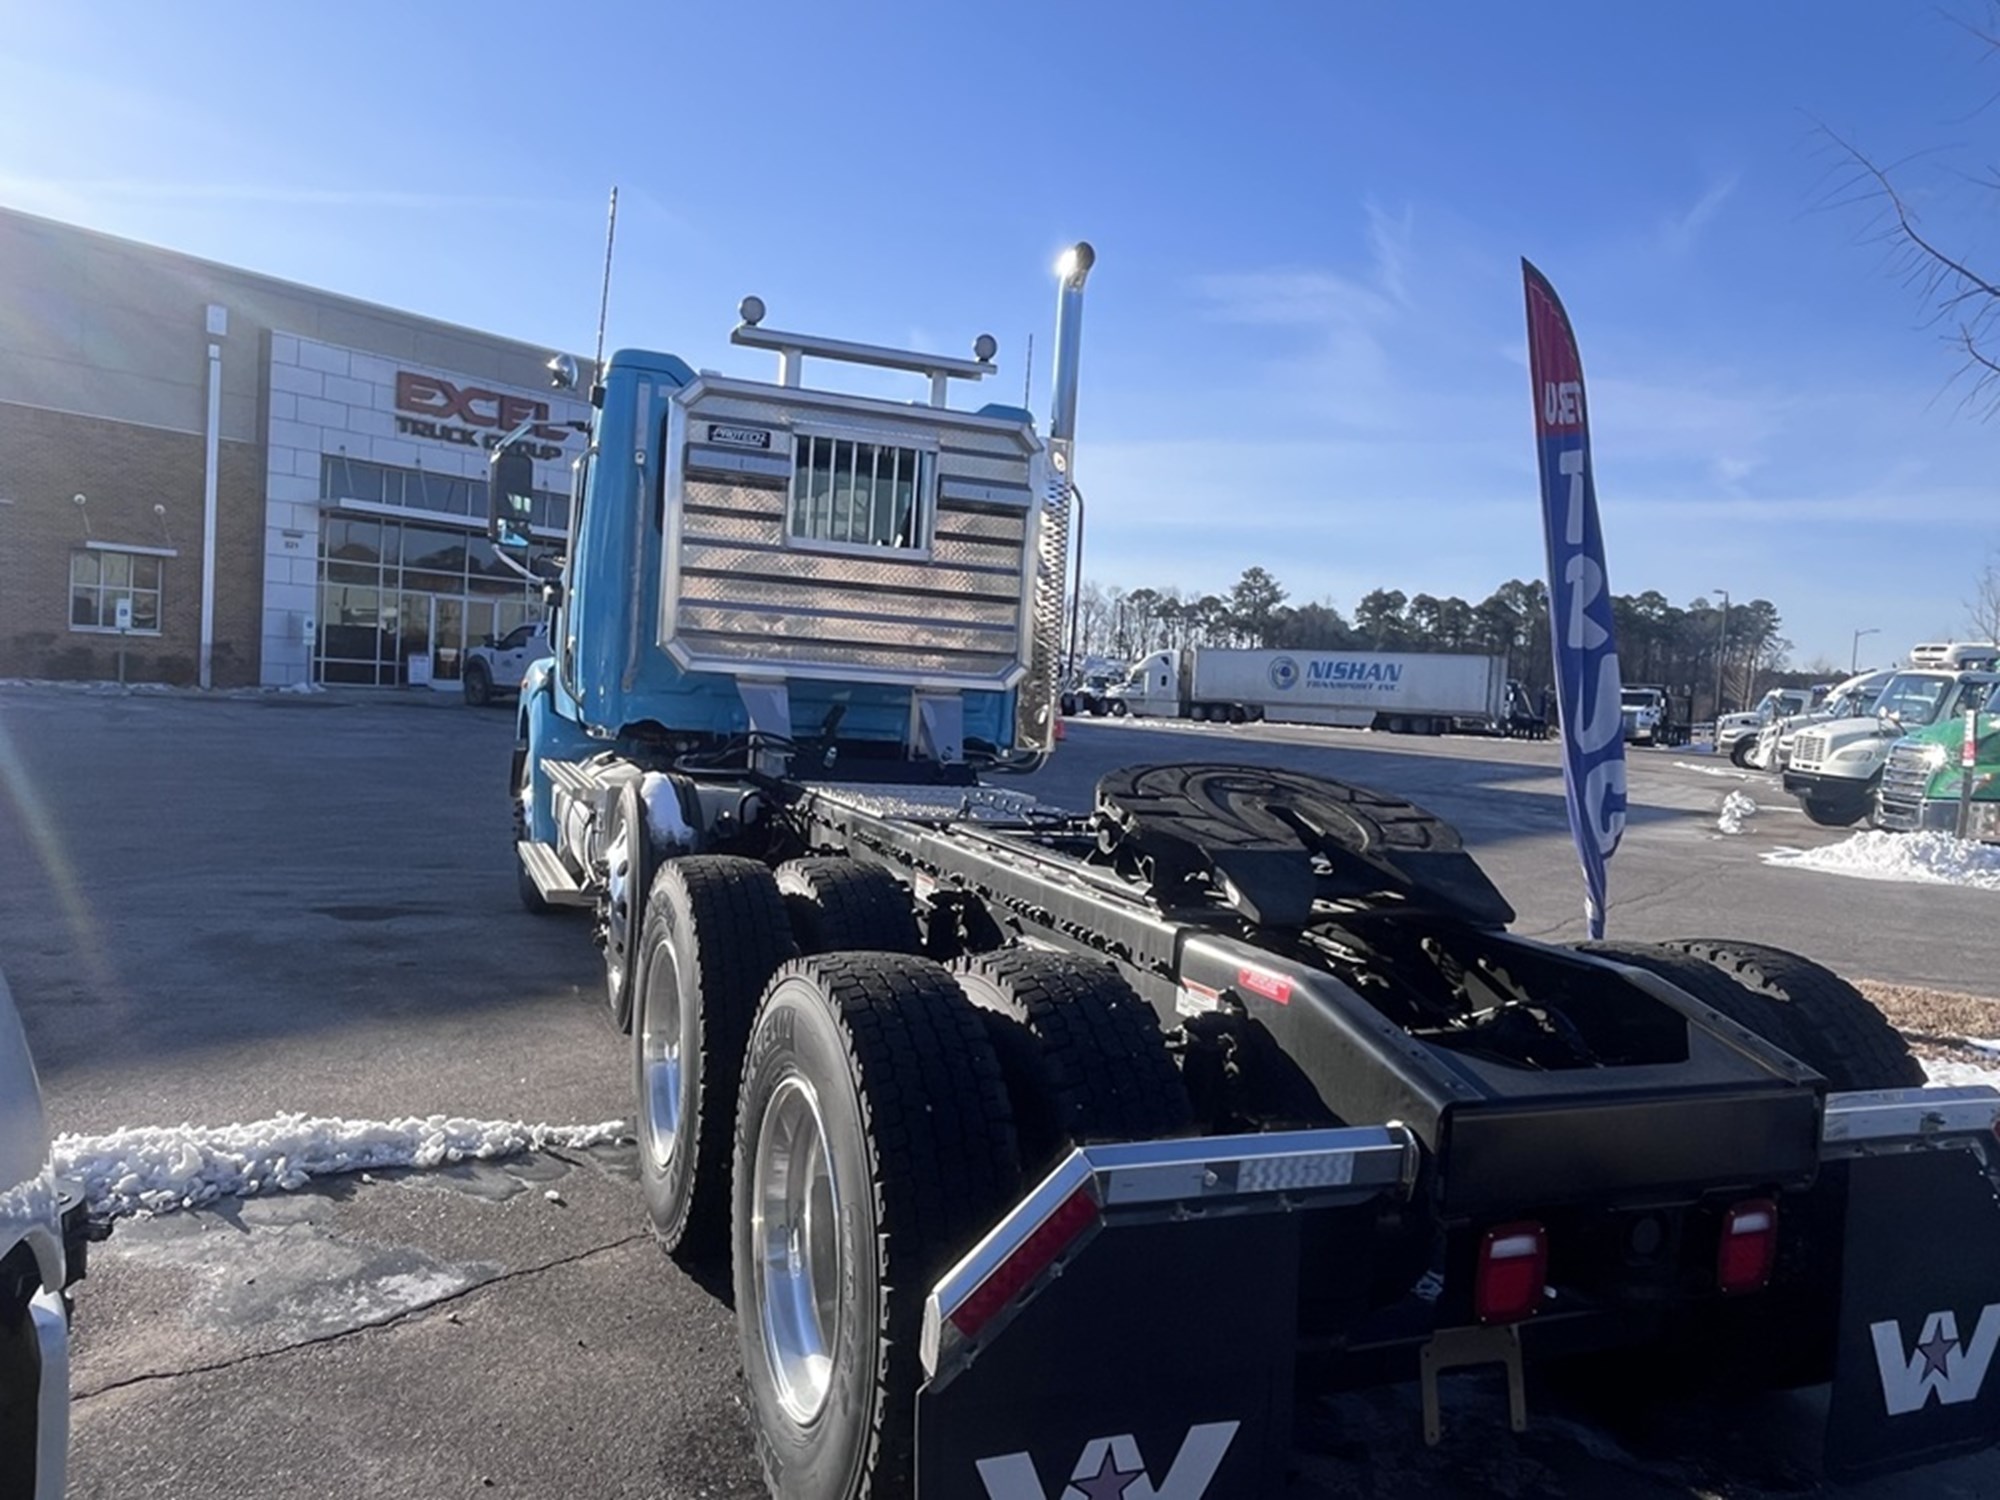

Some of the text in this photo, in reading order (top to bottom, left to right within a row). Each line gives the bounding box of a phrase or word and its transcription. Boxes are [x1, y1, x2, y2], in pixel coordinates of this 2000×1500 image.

[396, 371, 570, 441] EXCEL
[395, 415, 563, 460] TRUCK GOUP
[1306, 661, 1403, 682] NISHAN
[1306, 681, 1375, 691] TRANSPORT
